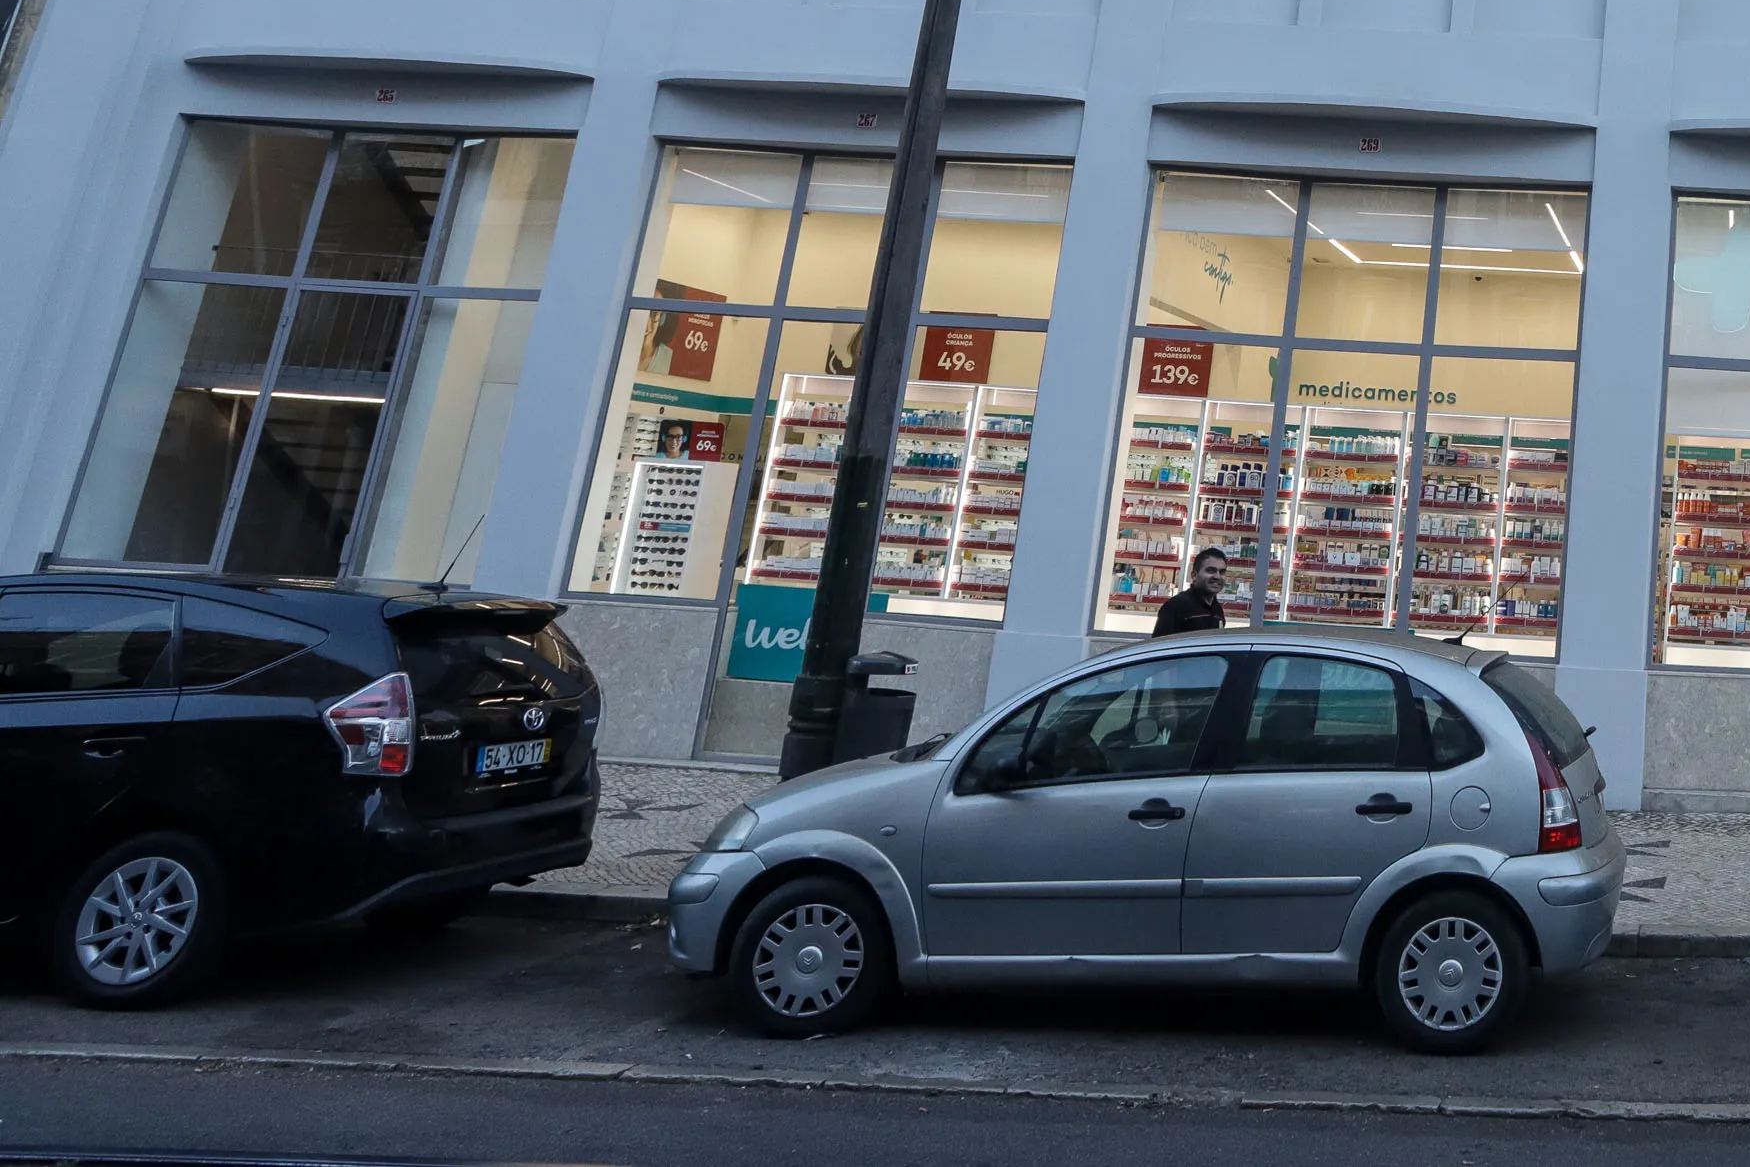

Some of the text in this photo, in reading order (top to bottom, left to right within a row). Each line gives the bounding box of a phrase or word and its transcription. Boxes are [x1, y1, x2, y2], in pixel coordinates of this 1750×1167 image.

[858, 114, 877, 127] 267
[1361, 138, 1379, 152] 269
[684, 329, 709, 353] 69€
[946, 331, 973, 340] ÓCULOS
[1164, 345, 1191, 353] ÓCULOS
[937, 351, 976, 372] 49€
[1153, 352, 1202, 360] PROGRESSIVOS
[1150, 364, 1199, 385] 139€
[1298, 381, 1457, 404] medicameos
[695, 440, 717, 452] 69€
